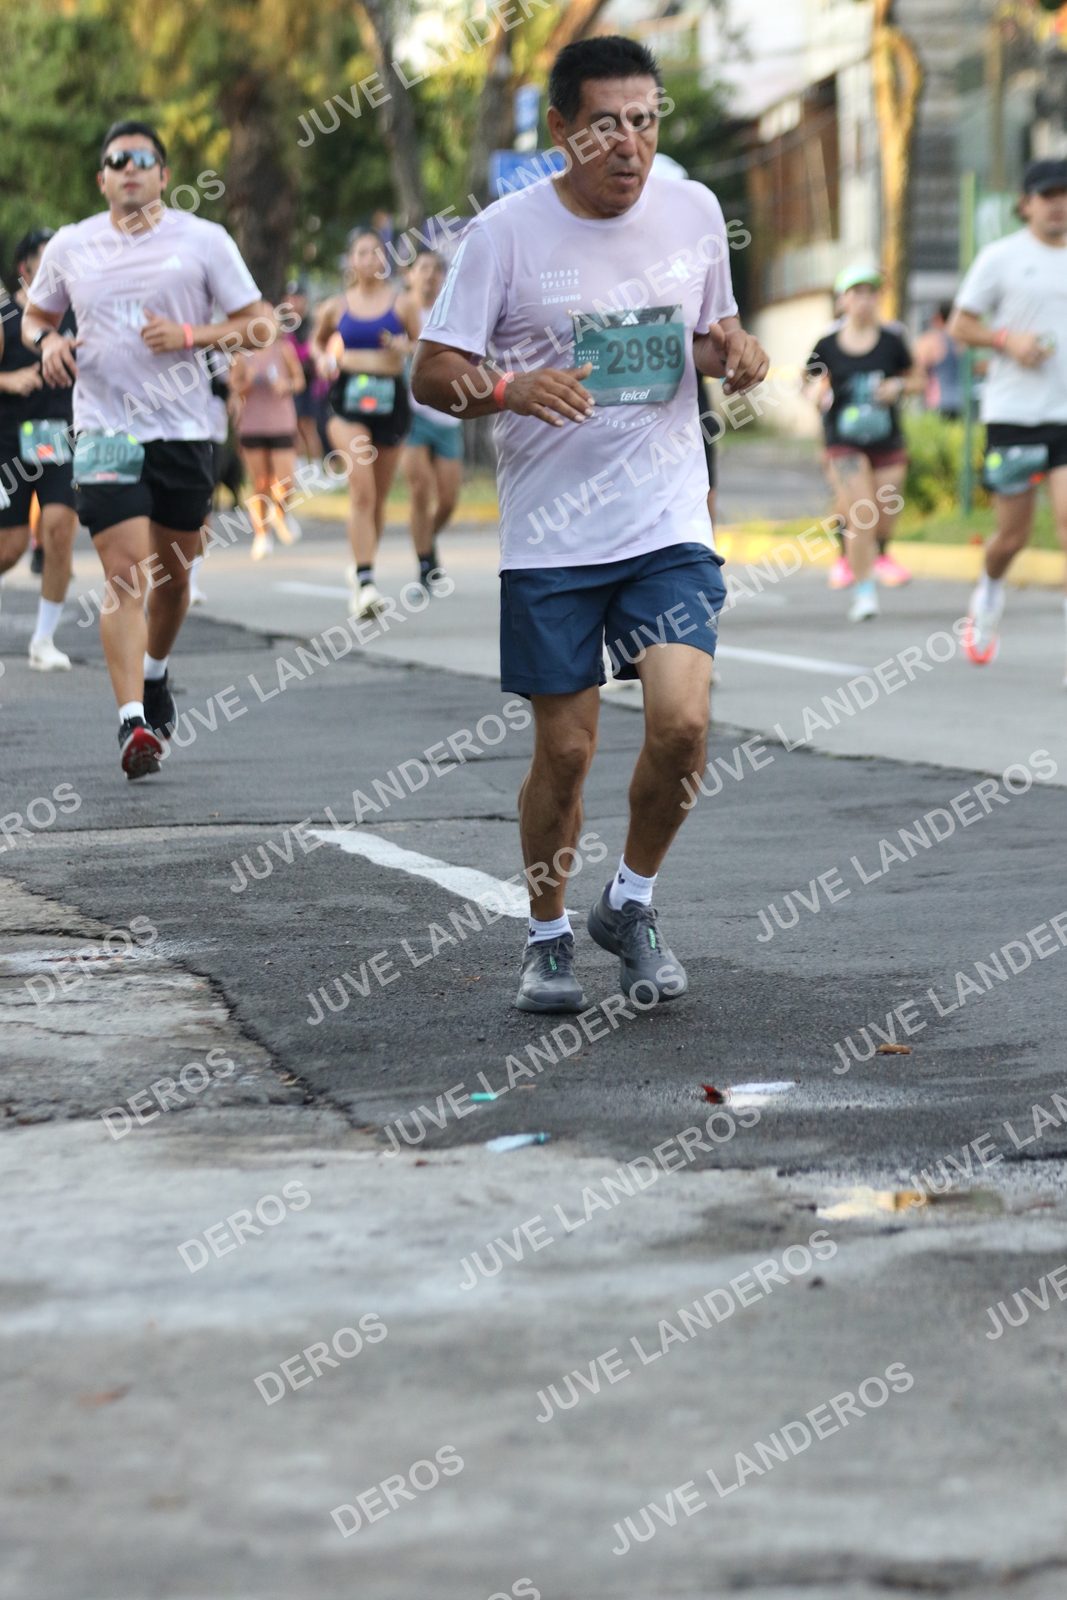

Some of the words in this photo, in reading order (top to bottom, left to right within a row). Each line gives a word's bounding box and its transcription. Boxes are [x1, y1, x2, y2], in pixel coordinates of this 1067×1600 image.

[540, 269, 580, 280] ADIDAS
[542, 278, 580, 288] SPLITS
[542, 294, 582, 305] SAMSUNG
[606, 335, 682, 374] 2989
[620, 389, 651, 401] telcel
